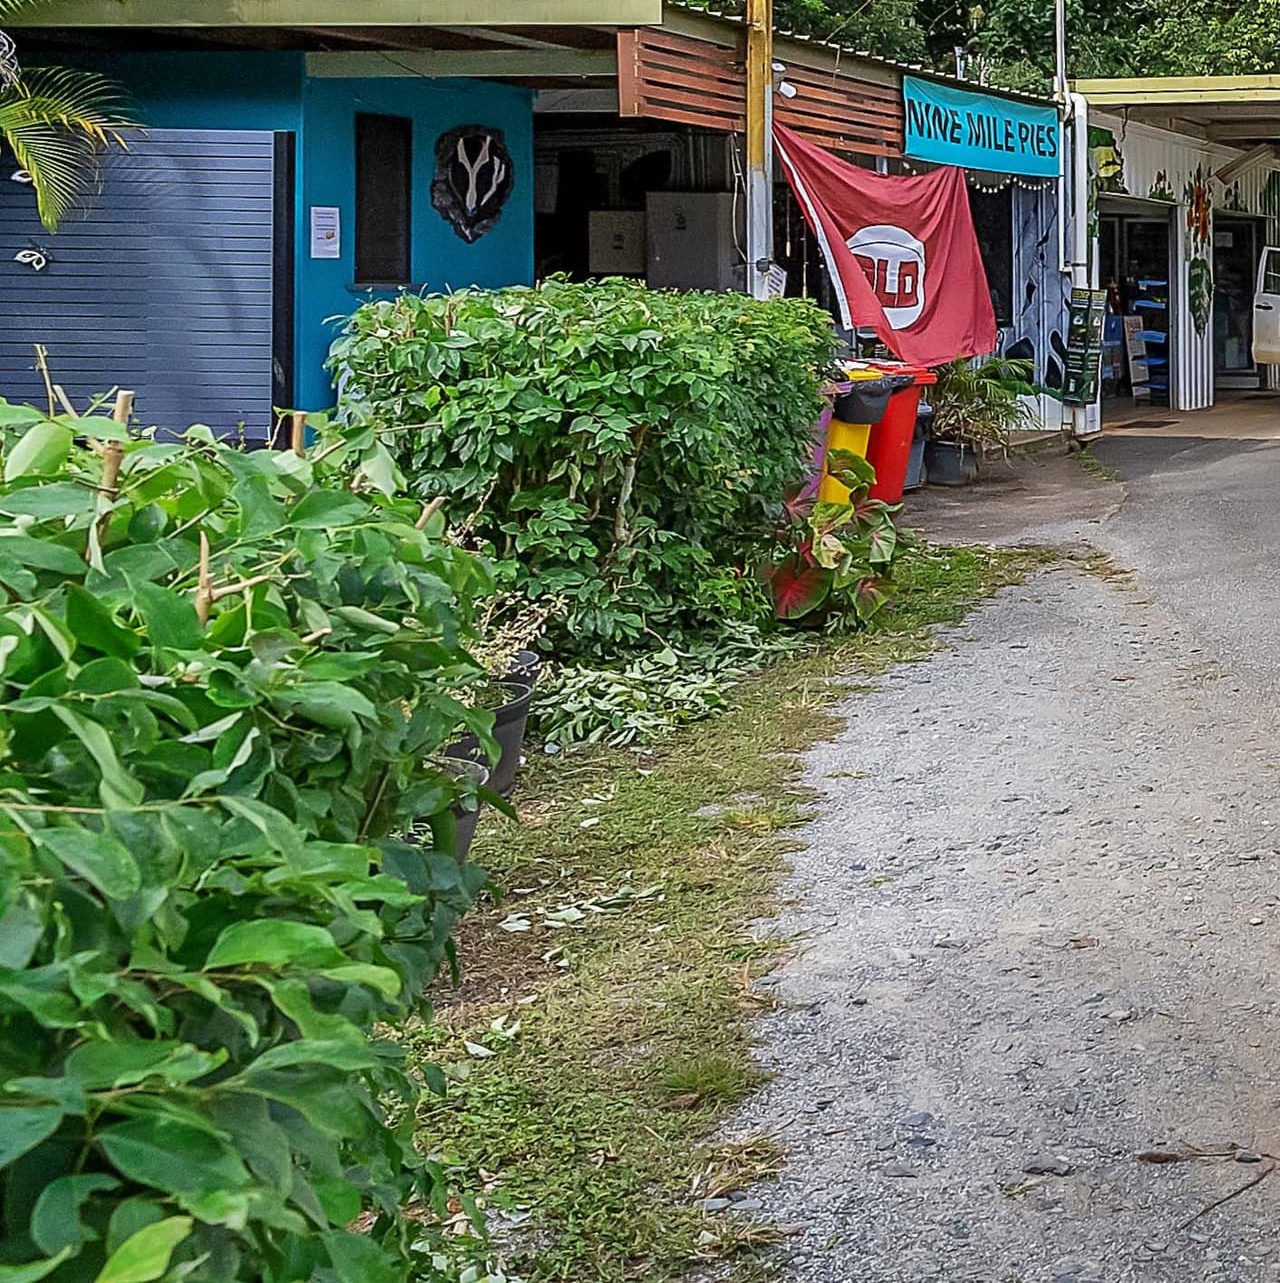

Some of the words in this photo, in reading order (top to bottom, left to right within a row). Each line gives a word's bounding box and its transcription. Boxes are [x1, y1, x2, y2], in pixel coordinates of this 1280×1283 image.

[906, 98, 962, 144] NINE
[966, 112, 1015, 153] MILE
[1018, 122, 1057, 158] PIES
